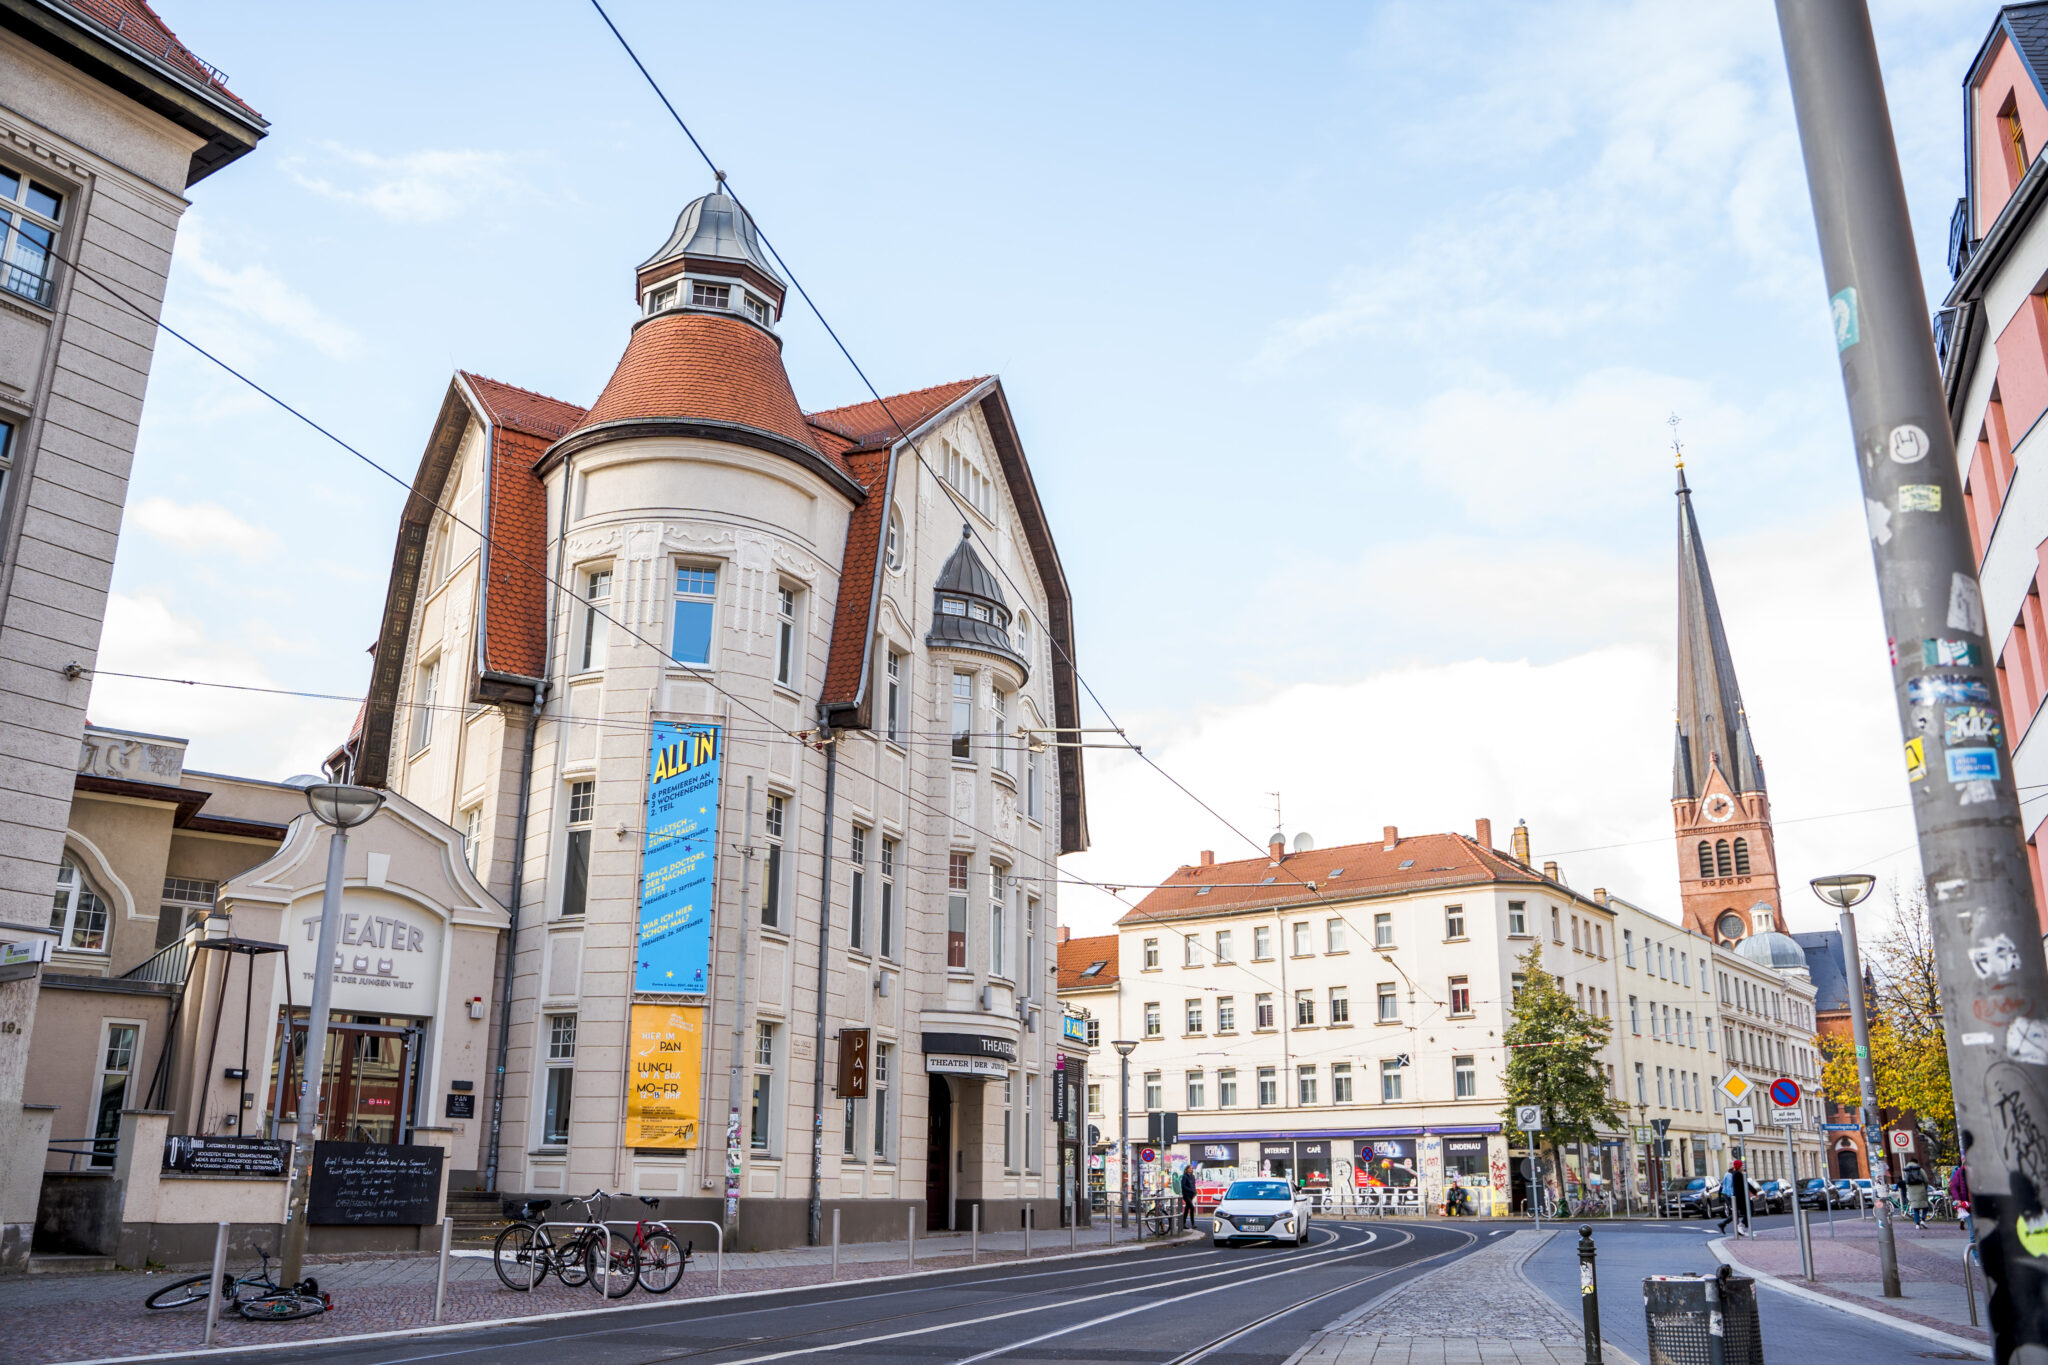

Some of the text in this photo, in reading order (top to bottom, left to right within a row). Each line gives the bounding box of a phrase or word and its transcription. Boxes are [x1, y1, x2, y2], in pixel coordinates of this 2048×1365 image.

[653, 728, 717, 784] ALL IN
[658, 776, 698, 797] PREMIEREN
[700, 771, 710, 780] AN
[657, 778, 714, 805] WOCHENENDEN
[659, 802, 674, 813] TEIL
[649, 832, 674, 847] ZUNGE
[682, 827, 709, 840] SEPTEMBER
[646, 866, 668, 880] SPACE
[645, 878, 660, 889] DER
[645, 883, 665, 898] BITTE
[678, 877, 706, 891] SEPTEMBER
[642, 904, 693, 930] WAR ICH HIER
[303, 913, 424, 952] TEATER
[642, 914, 690, 940] SCHON MAL?
[676, 918, 703, 933] SEPTEMBER
[359, 977, 391, 987] JUNGEN
[393, 981, 414, 989] WELT
[665, 1032, 675, 1040] IM
[660, 1041, 681, 1052] PAN
[981, 1039, 1011, 1054] THEATER
[637, 1062, 672, 1073] LUNCH
[930, 1058, 969, 1067] THEATER
[640, 1070, 649, 1079] IN
[653, 1071, 660, 1079] A
[665, 1091, 681, 1099] UHR
[1897, 1136, 1907, 1144] 30
